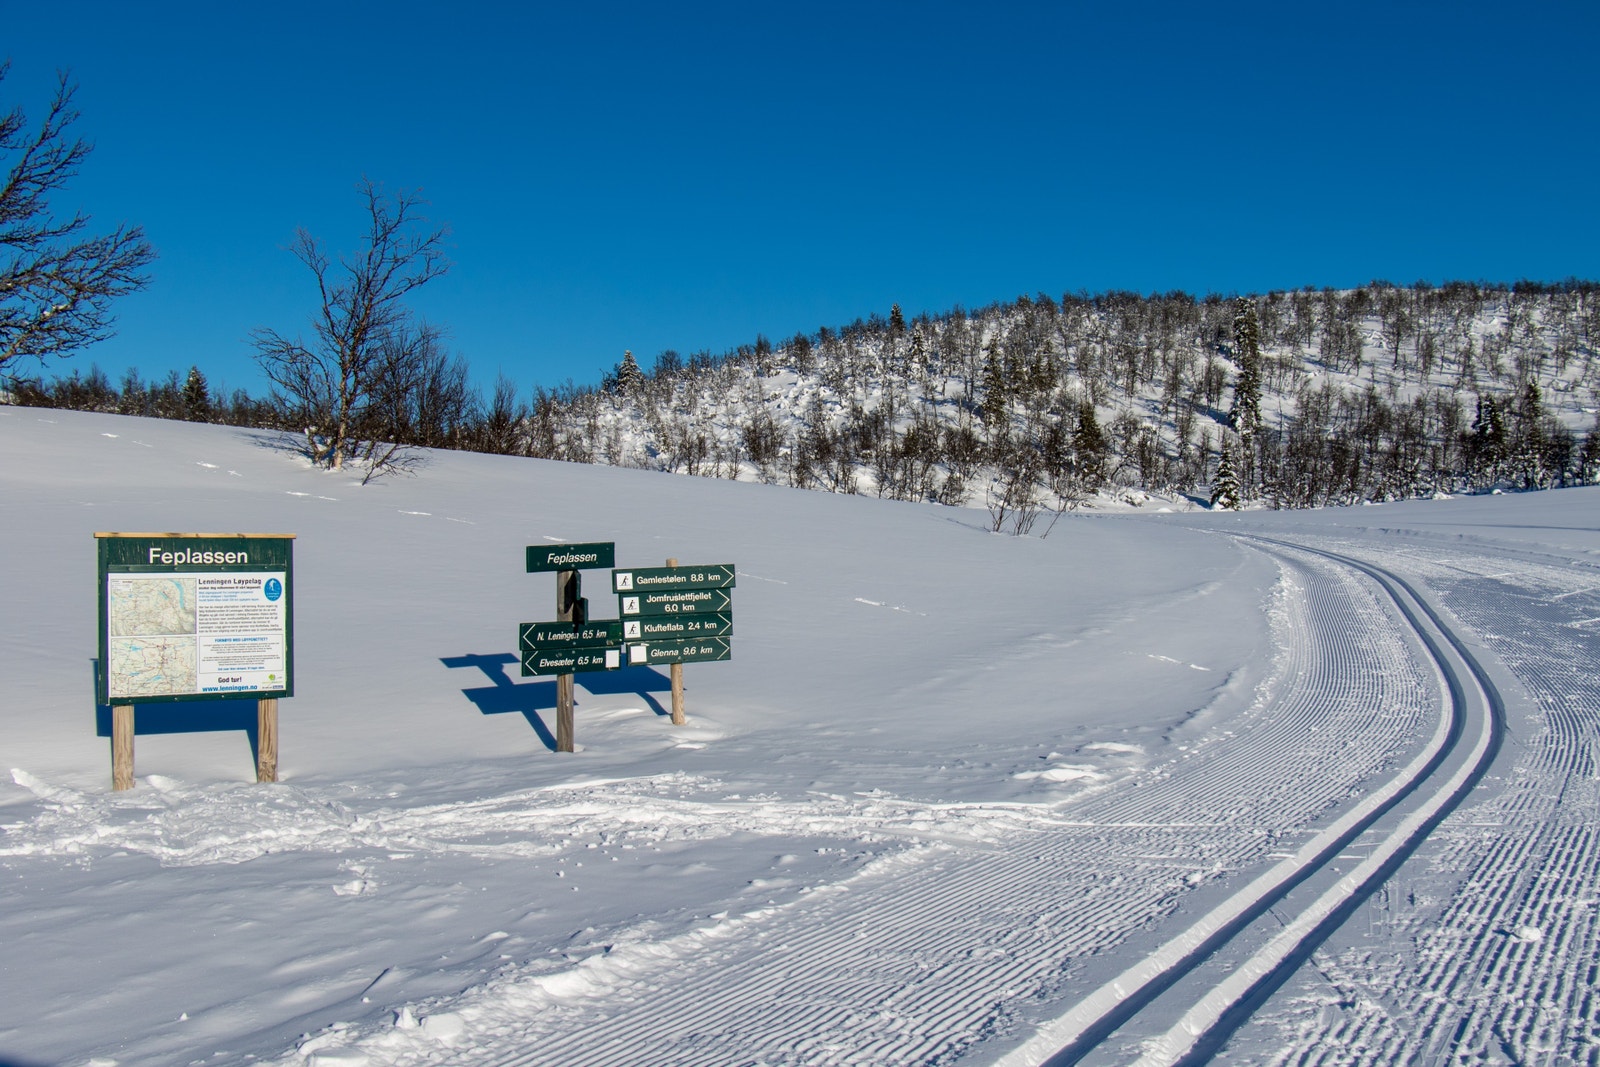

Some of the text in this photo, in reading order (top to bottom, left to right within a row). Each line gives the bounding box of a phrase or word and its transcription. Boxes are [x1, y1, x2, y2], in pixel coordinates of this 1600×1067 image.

[149, 547, 248, 566] Feplassen
[547, 552, 597, 566] Feplassen
[198, 578, 262, 586] Lenningen Løypelag
[636, 575, 687, 585] Gamlestølen
[708, 573, 721, 581] km
[646, 592, 712, 603] Jomfruslettfjellet
[682, 603, 695, 611] km
[644, 623, 684, 633] Klufteflata
[705, 621, 717, 629] km
[536, 631, 544, 641] N.
[596, 629, 607, 638] km
[650, 648, 679, 658] Glenna
[700, 646, 713, 654] km
[539, 658, 575, 668] Elvesæter
[592, 655, 604, 664] km
